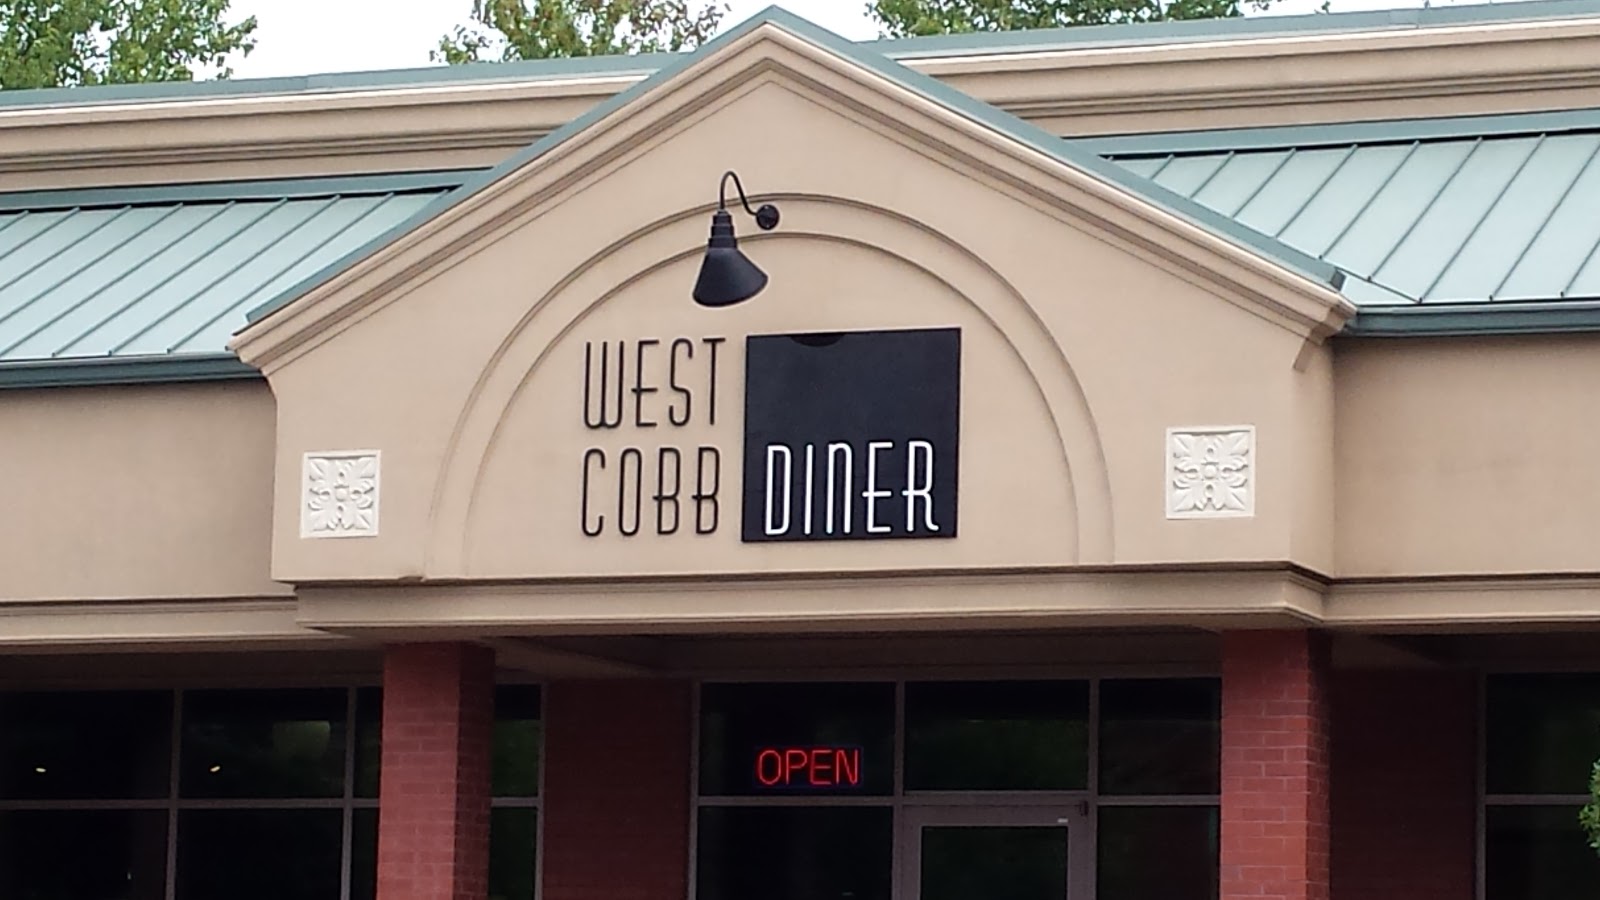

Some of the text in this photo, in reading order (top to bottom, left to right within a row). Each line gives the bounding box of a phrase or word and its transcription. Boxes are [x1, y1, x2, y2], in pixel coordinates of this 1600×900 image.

[584, 338, 725, 429] WEST
[582, 440, 939, 536] COBB DINER
[756, 749, 860, 786] OPEN
